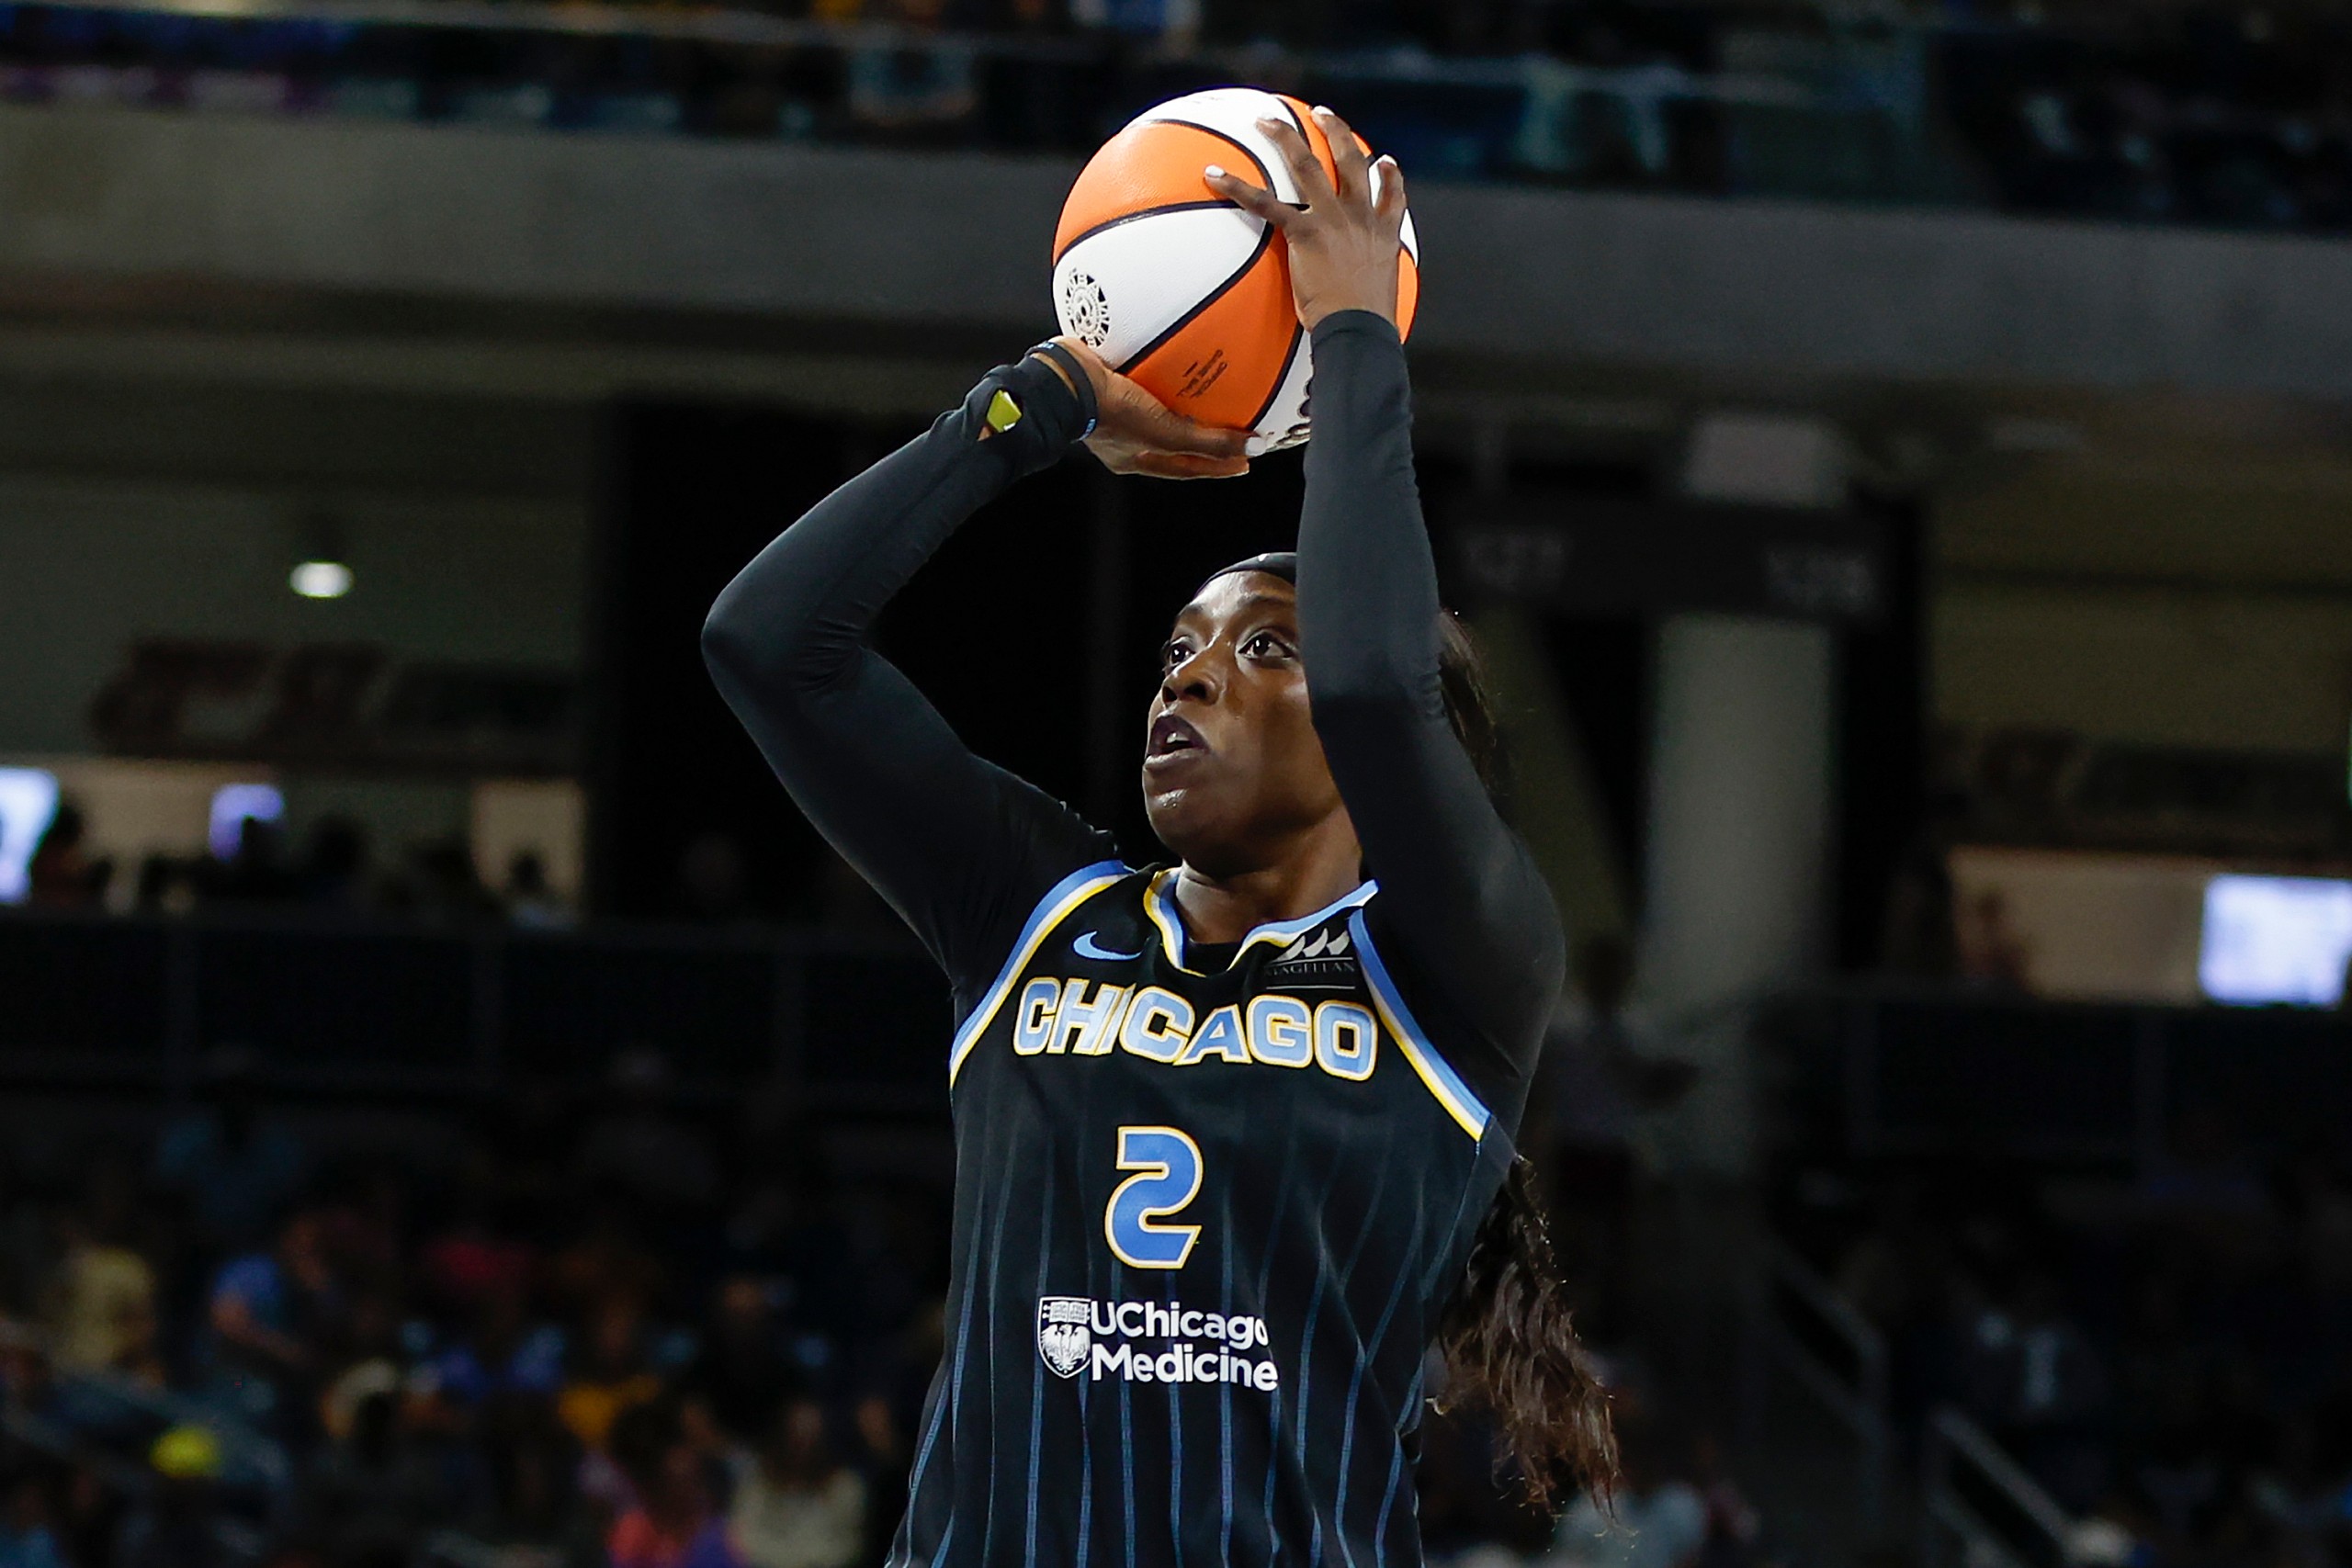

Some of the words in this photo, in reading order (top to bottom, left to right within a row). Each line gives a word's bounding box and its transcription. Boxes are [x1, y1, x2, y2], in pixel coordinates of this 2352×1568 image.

[1013, 976, 1377, 1081] CHICAGO
[1104, 1125, 1204, 1269] 2
[1091, 1301, 1269, 1350] UChicago
[1091, 1343, 1278, 1392] Medicine
